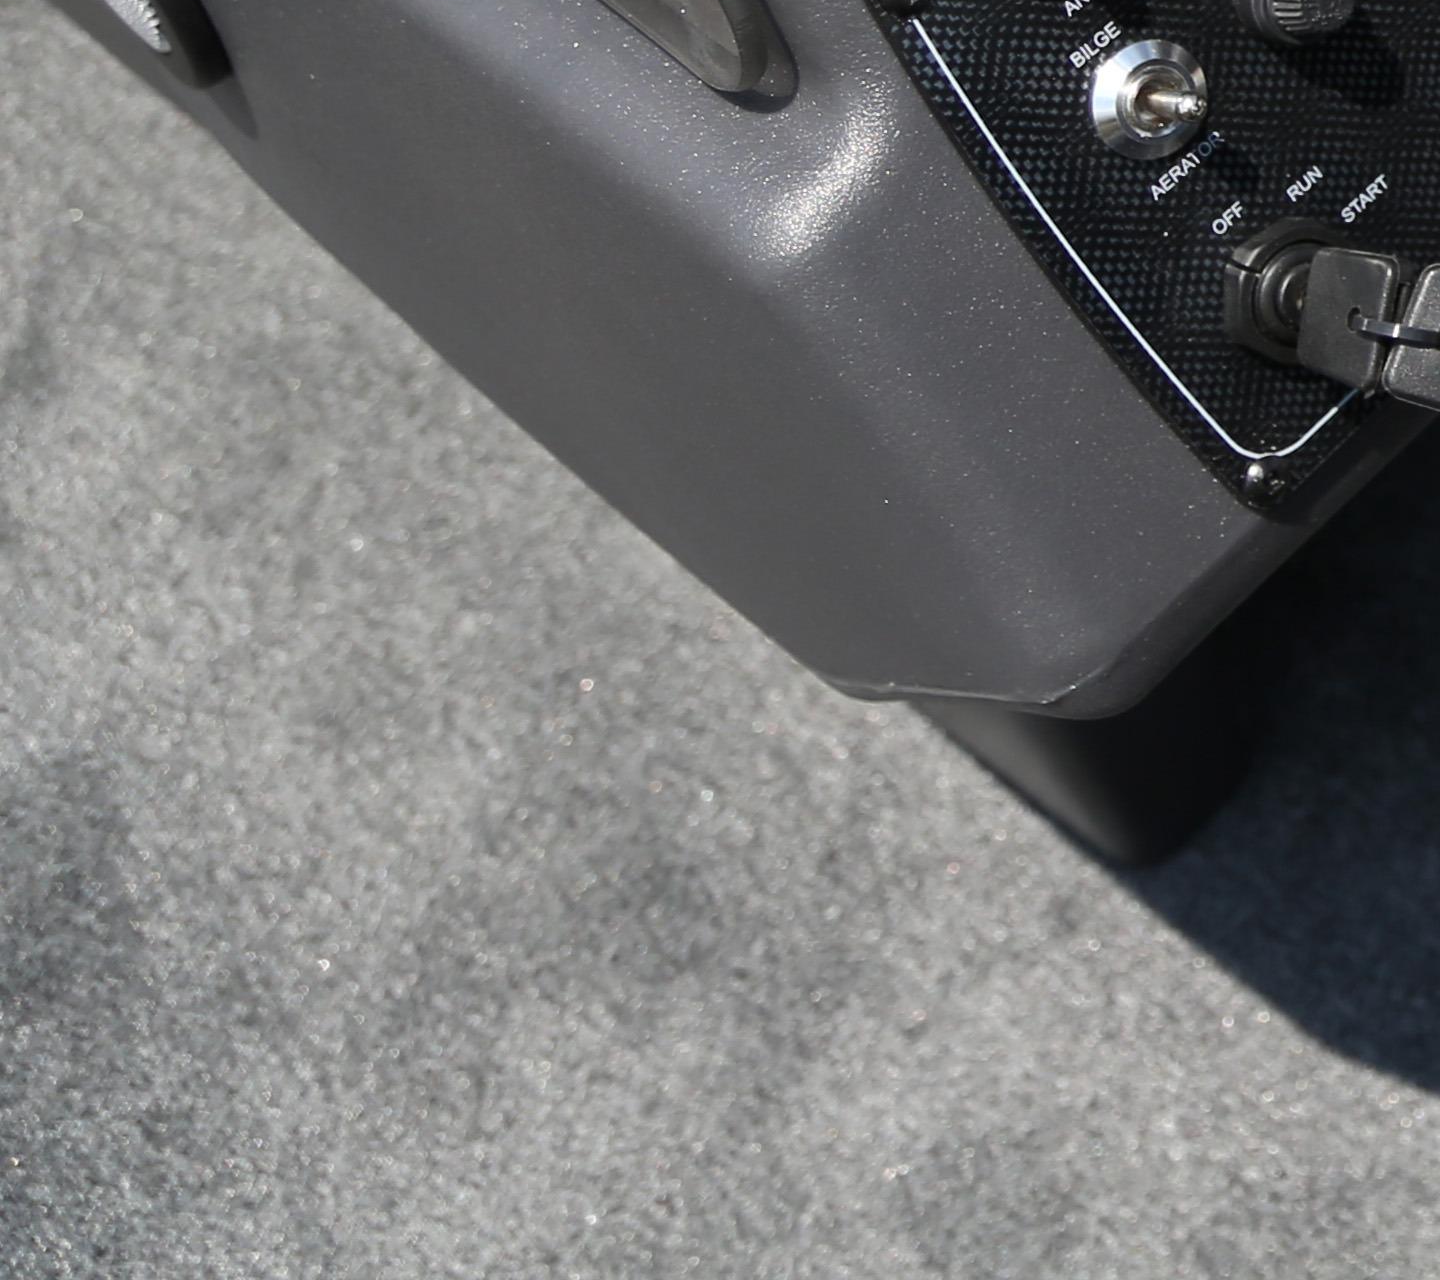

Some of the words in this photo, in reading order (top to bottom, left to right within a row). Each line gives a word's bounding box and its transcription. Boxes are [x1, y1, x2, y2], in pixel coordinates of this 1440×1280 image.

[1068, 20, 1122, 69] BILGE
[1150, 130, 1226, 201] AERATOR
[1285, 165, 1324, 203] RUN
[1211, 200, 1245, 236] OFF
[1340, 173, 1389, 224] START
